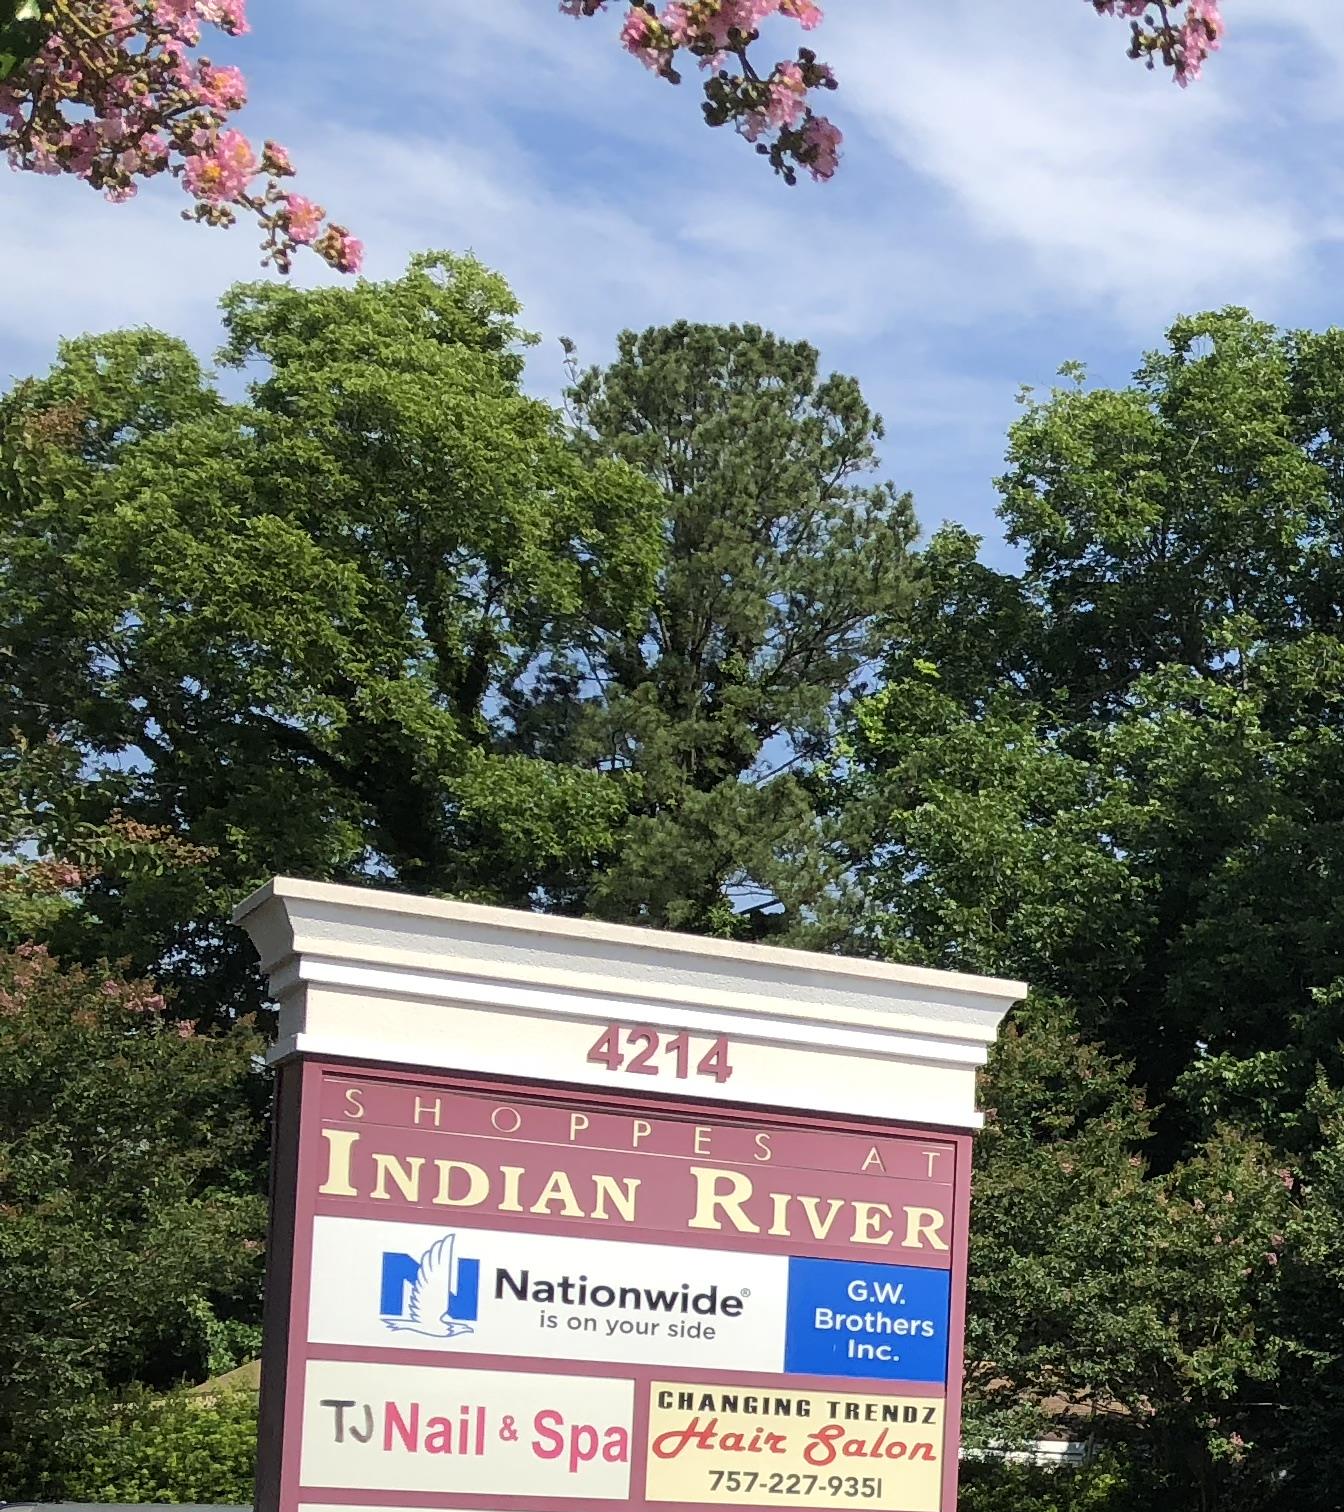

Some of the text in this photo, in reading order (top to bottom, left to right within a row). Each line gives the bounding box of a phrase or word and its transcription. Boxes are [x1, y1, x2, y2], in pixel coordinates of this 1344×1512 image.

[587, 1023, 733, 1083] 4214
[343, 1088, 941, 1179] SHOPPES AT
[319, 1128, 950, 1253] INDIAN RIVER
[846, 1280, 906, 1305] G.W.
[539, 1309, 717, 1341] is on your side
[814, 1308, 935, 1338] Brothers
[847, 1339, 900, 1362] Inc.
[657, 1390, 938, 1425] CHANGING TRENDZ
[319, 1399, 629, 1473] TJ Nail & Spa
[651, 1416, 937, 1467] Hair Salon
[707, 1469, 883, 1499] 757-227-9351
